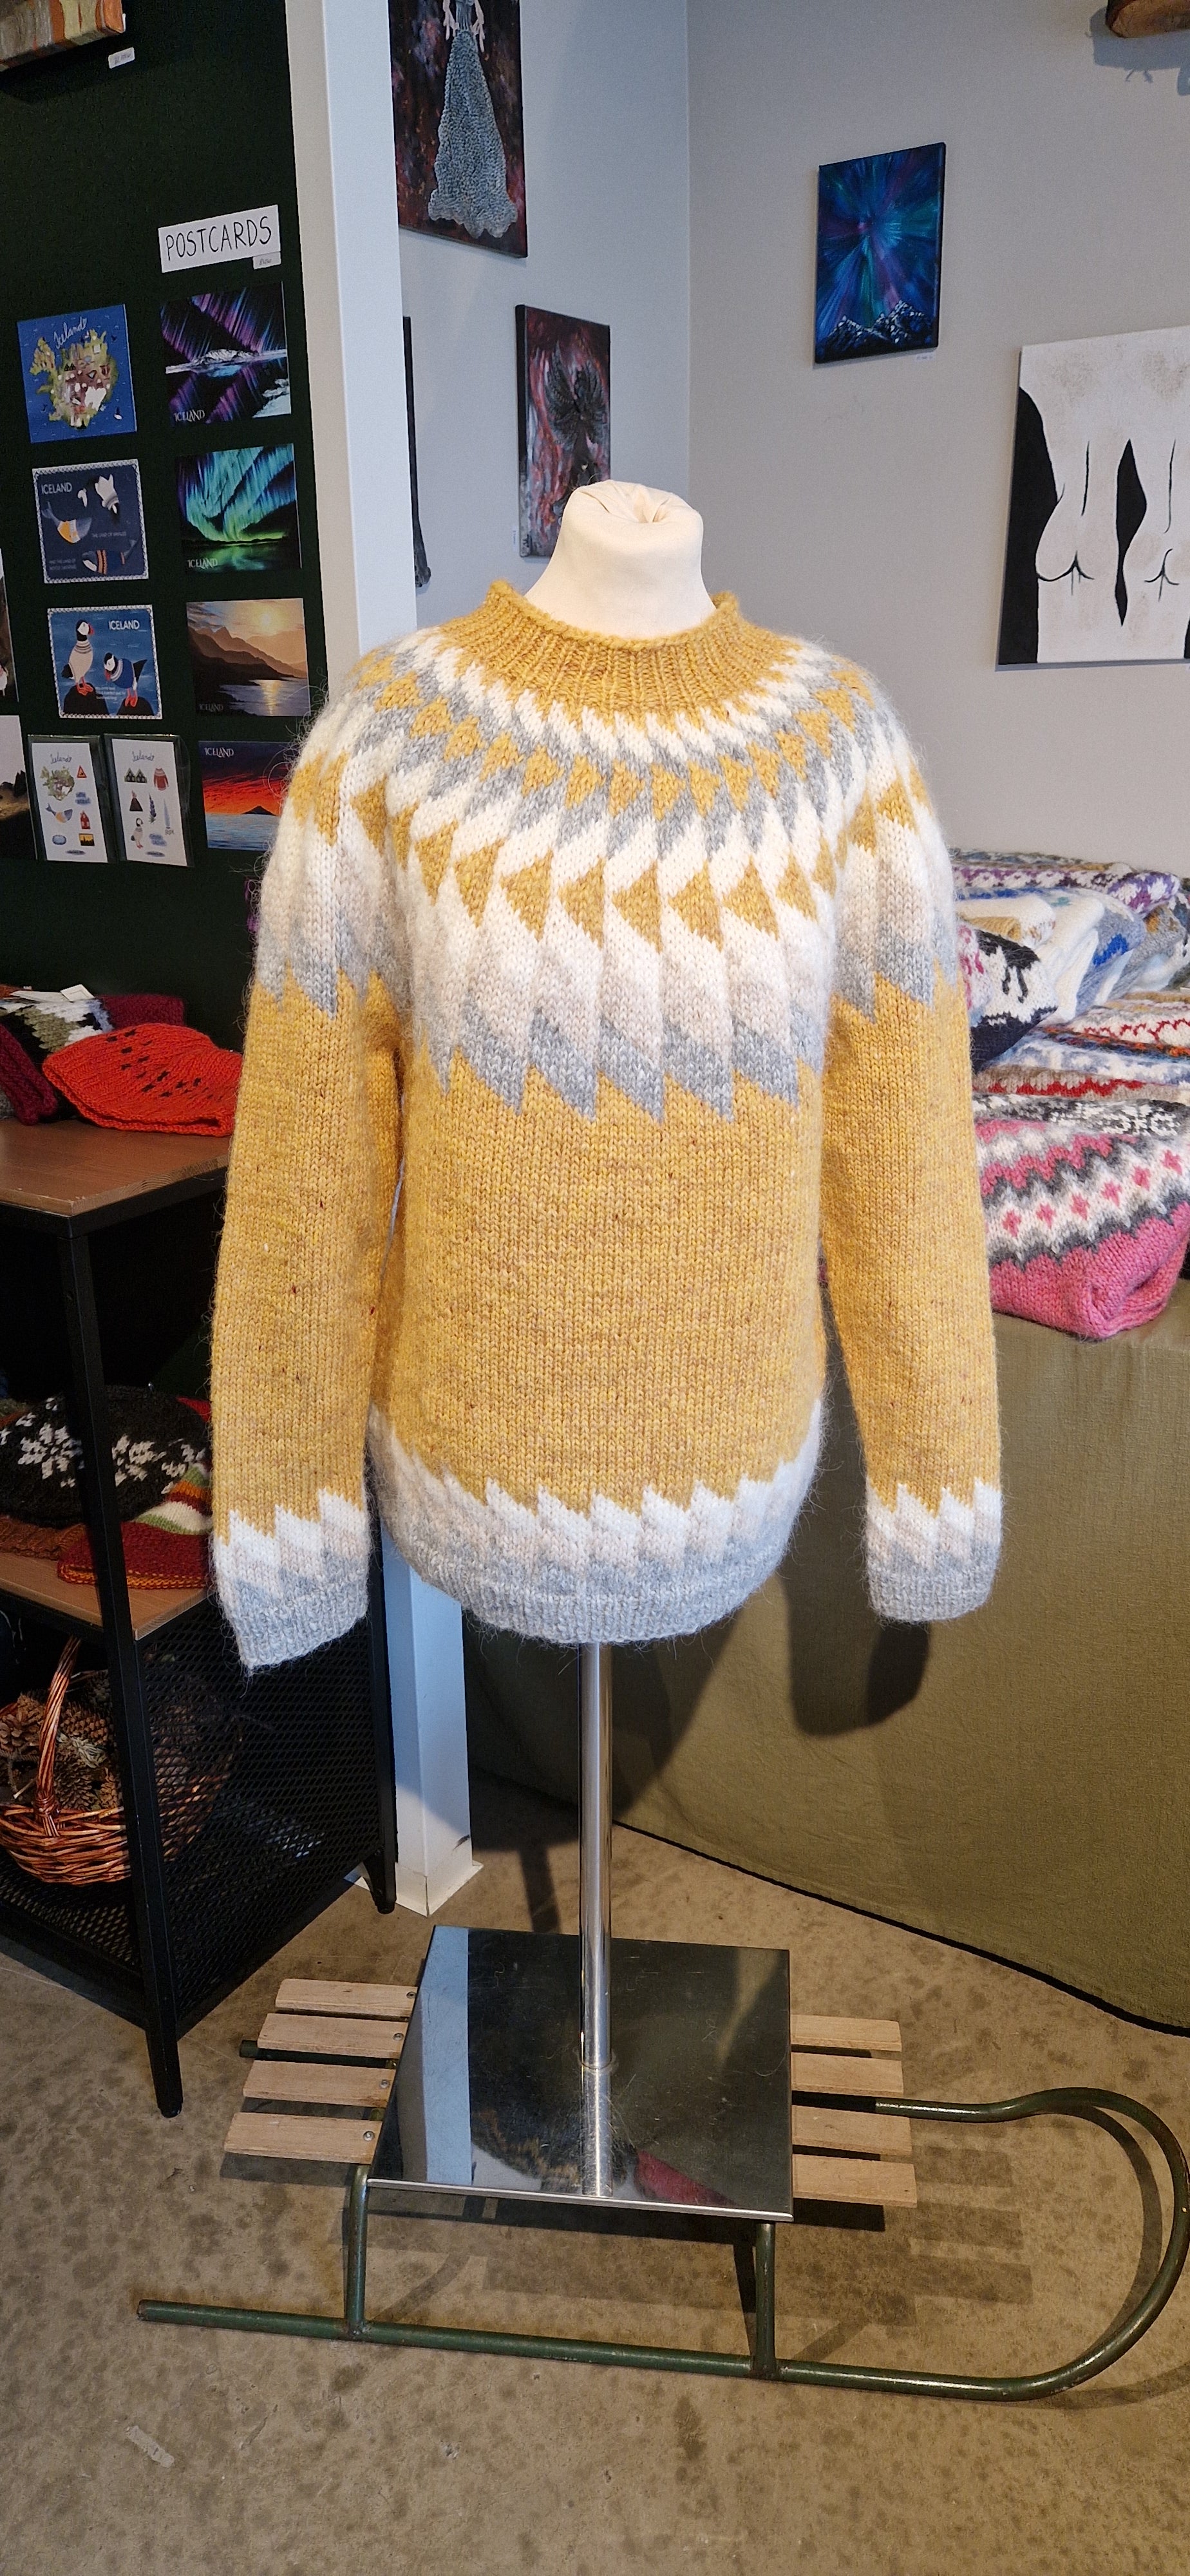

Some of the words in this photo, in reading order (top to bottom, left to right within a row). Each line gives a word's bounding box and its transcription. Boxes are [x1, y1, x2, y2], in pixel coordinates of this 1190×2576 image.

[165, 216, 272, 261] POSTCARDS
[174, 409, 205, 422] ICELAND
[41, 482, 73, 495] ICELAND
[187, 557, 218, 569] ICELAND
[108, 620, 140, 630] ICELAND
[204, 747, 234, 758] ICELAND
